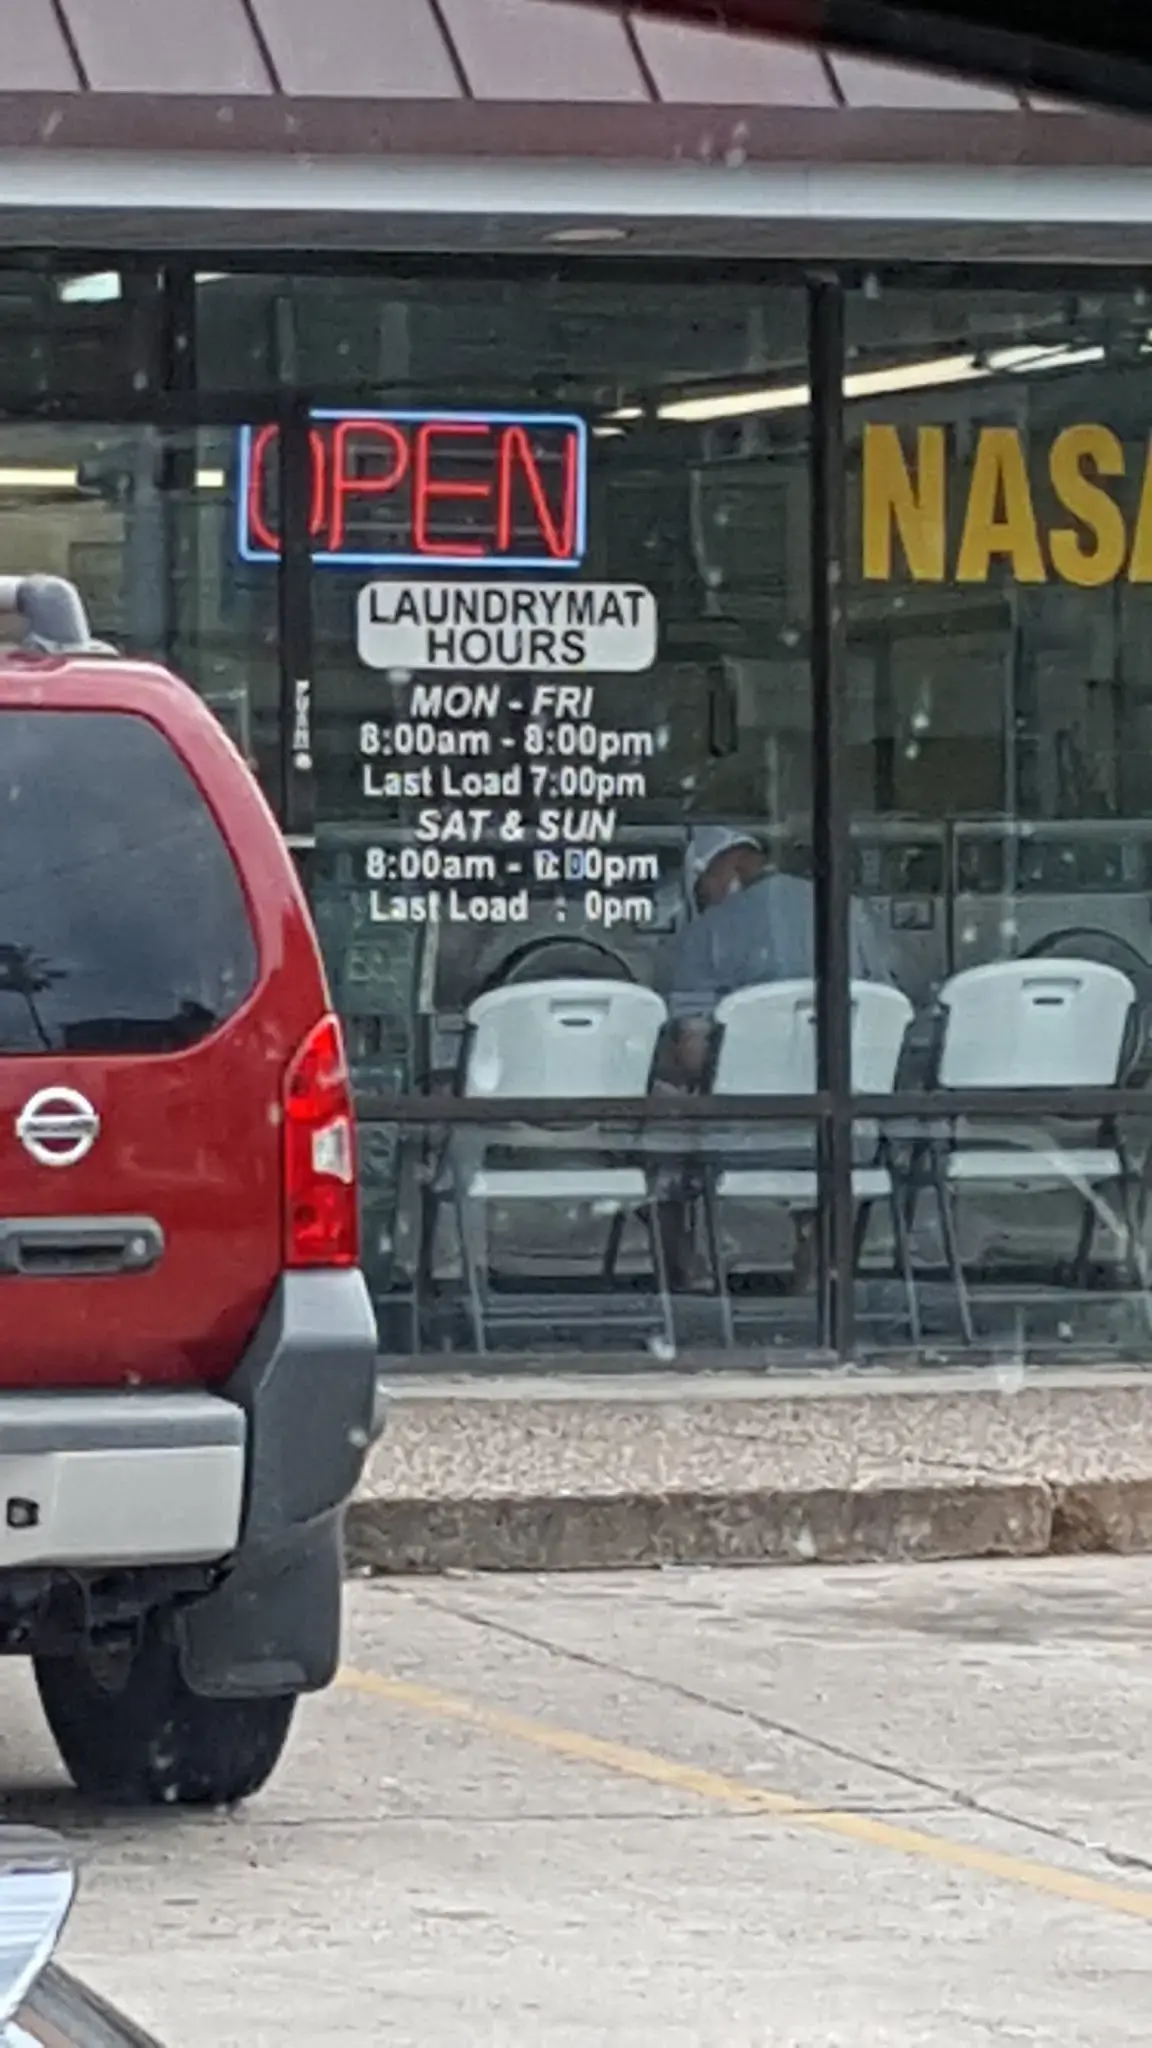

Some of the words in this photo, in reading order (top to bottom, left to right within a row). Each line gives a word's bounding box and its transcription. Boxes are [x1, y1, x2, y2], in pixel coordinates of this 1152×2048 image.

[248, 420, 577, 557] OPEN
[862, 422, 1152, 587] NAS
[369, 587, 645, 626] LAUNDRYMAT
[427, 629, 587, 665] HOURS
[410, 685, 500, 718] MON
[531, 685, 594, 718] FRI
[360, 721, 490, 755] 8:00am
[524, 723, 654, 763] 8:00pm
[363, 763, 433, 796] Last
[442, 763, 522, 796] Load
[530, 765, 646, 804] 7:00pm
[415, 808, 491, 842] SAT
[500, 808, 526, 841] &
[536, 808, 616, 842] SUN
[365, 846, 496, 880] 8:00am
[369, 888, 441, 922] Last
[450, 888, 529, 922] Load
